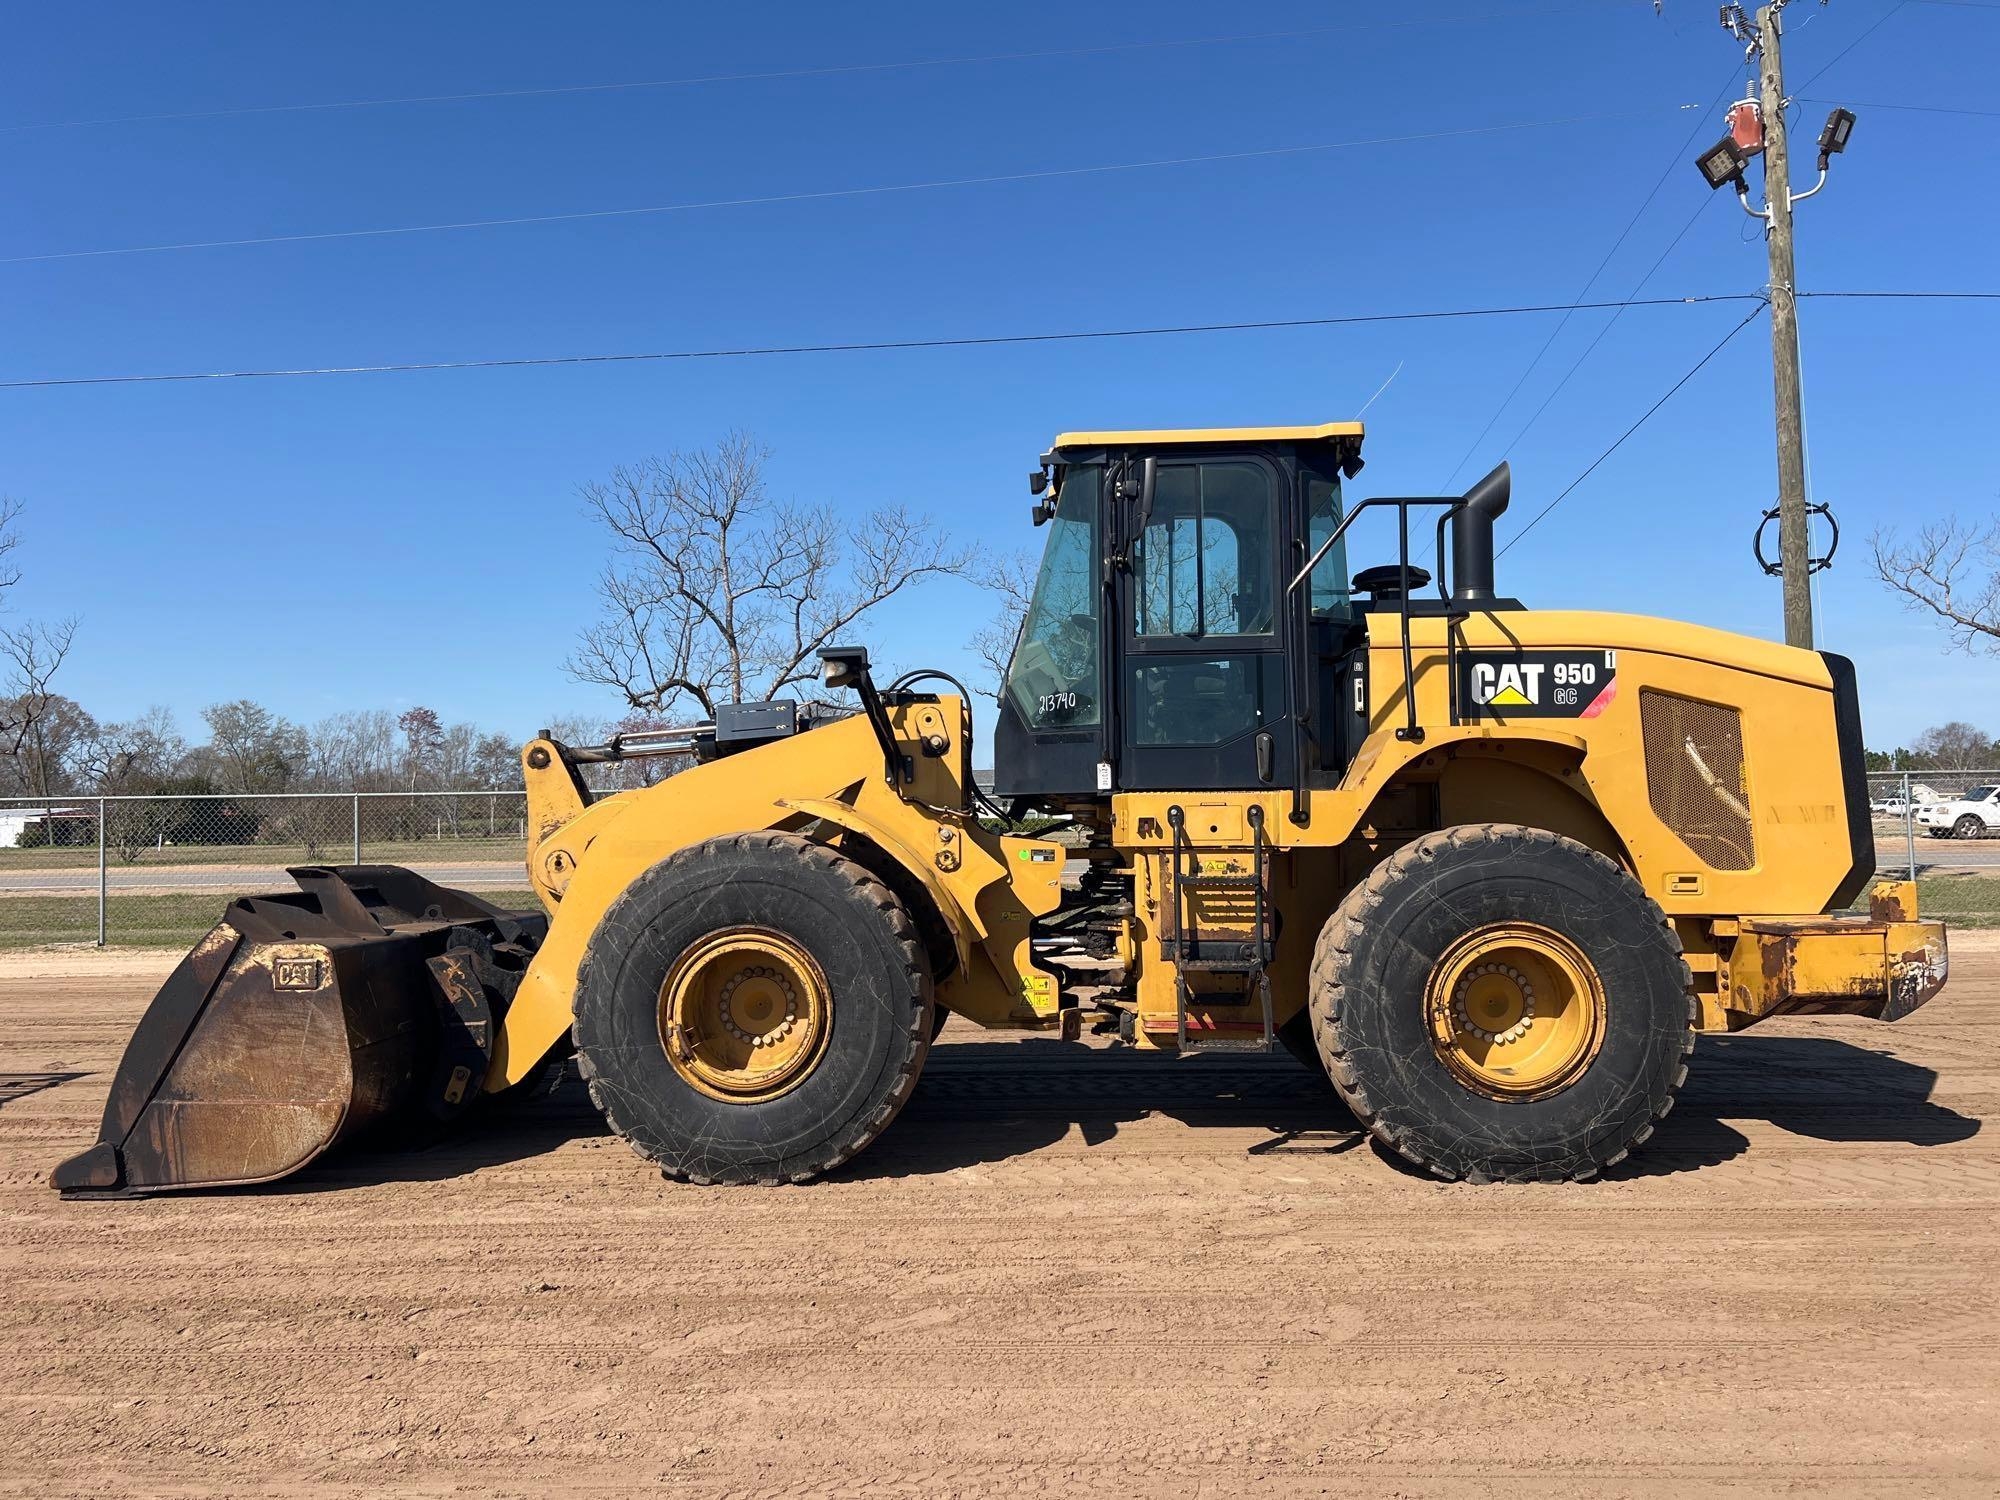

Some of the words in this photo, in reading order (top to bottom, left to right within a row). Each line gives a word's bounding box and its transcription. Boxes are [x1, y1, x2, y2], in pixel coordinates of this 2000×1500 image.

[1471, 663, 1544, 705] CAT
[1553, 663, 1595, 684] 950
[1039, 692, 1076, 714] 213740
[1553, 687, 1577, 704] GC
[279, 963, 313, 985] CAT
